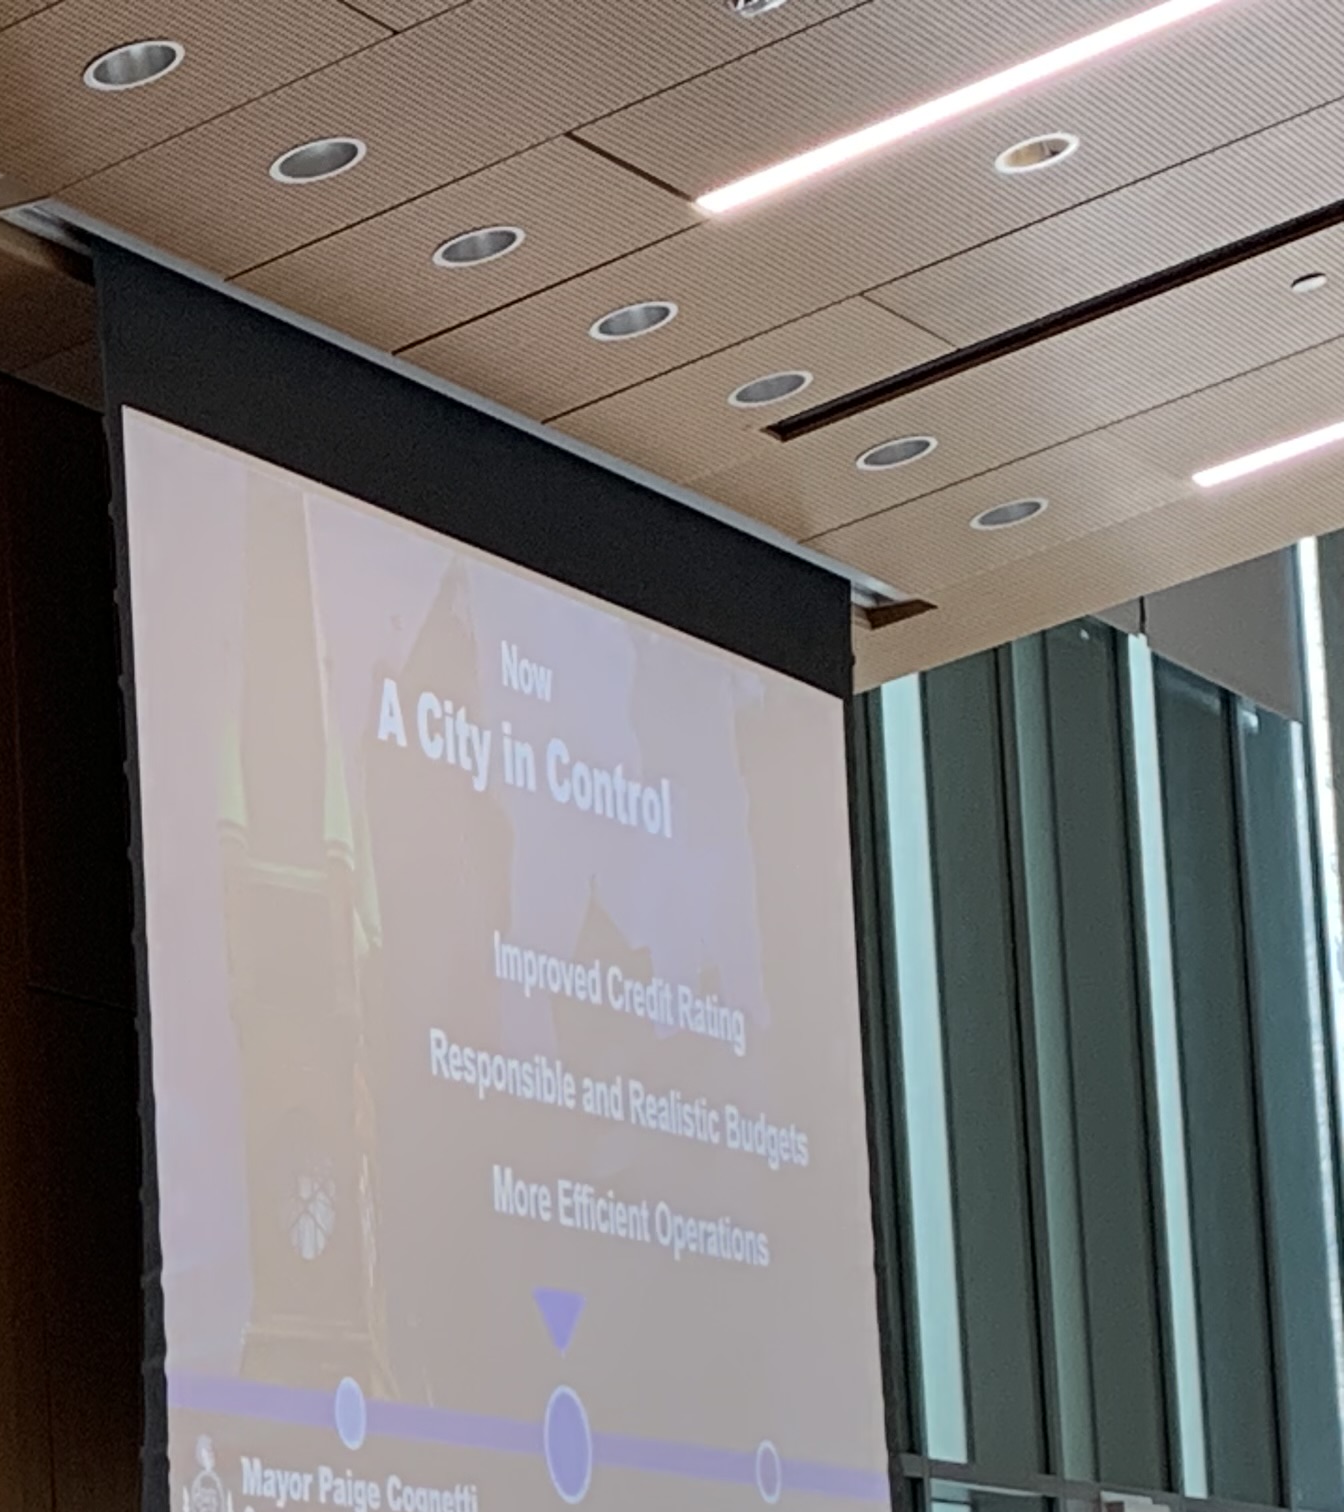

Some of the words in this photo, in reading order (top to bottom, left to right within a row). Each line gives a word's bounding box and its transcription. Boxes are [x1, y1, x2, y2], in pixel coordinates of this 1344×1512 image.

[500, 640, 552, 702] Now
[377, 678, 408, 748] A
[417, 692, 492, 793] City
[502, 721, 537, 793] in
[546, 737, 673, 839] Control
[493, 930, 603, 1005] Improved
[606, 965, 674, 1026] Credit
[677, 983, 746, 1057] Rating
[429, 1027, 577, 1109] Responsible
[582, 1074, 625, 1121] and
[628, 1079, 721, 1145] Realistic
[724, 1104, 810, 1171] Budgets
[492, 1164, 552, 1222] More
[557, 1178, 651, 1243] Efficient
[655, 1201, 771, 1267] Operations
[240, 1456, 313, 1508] Mayor
